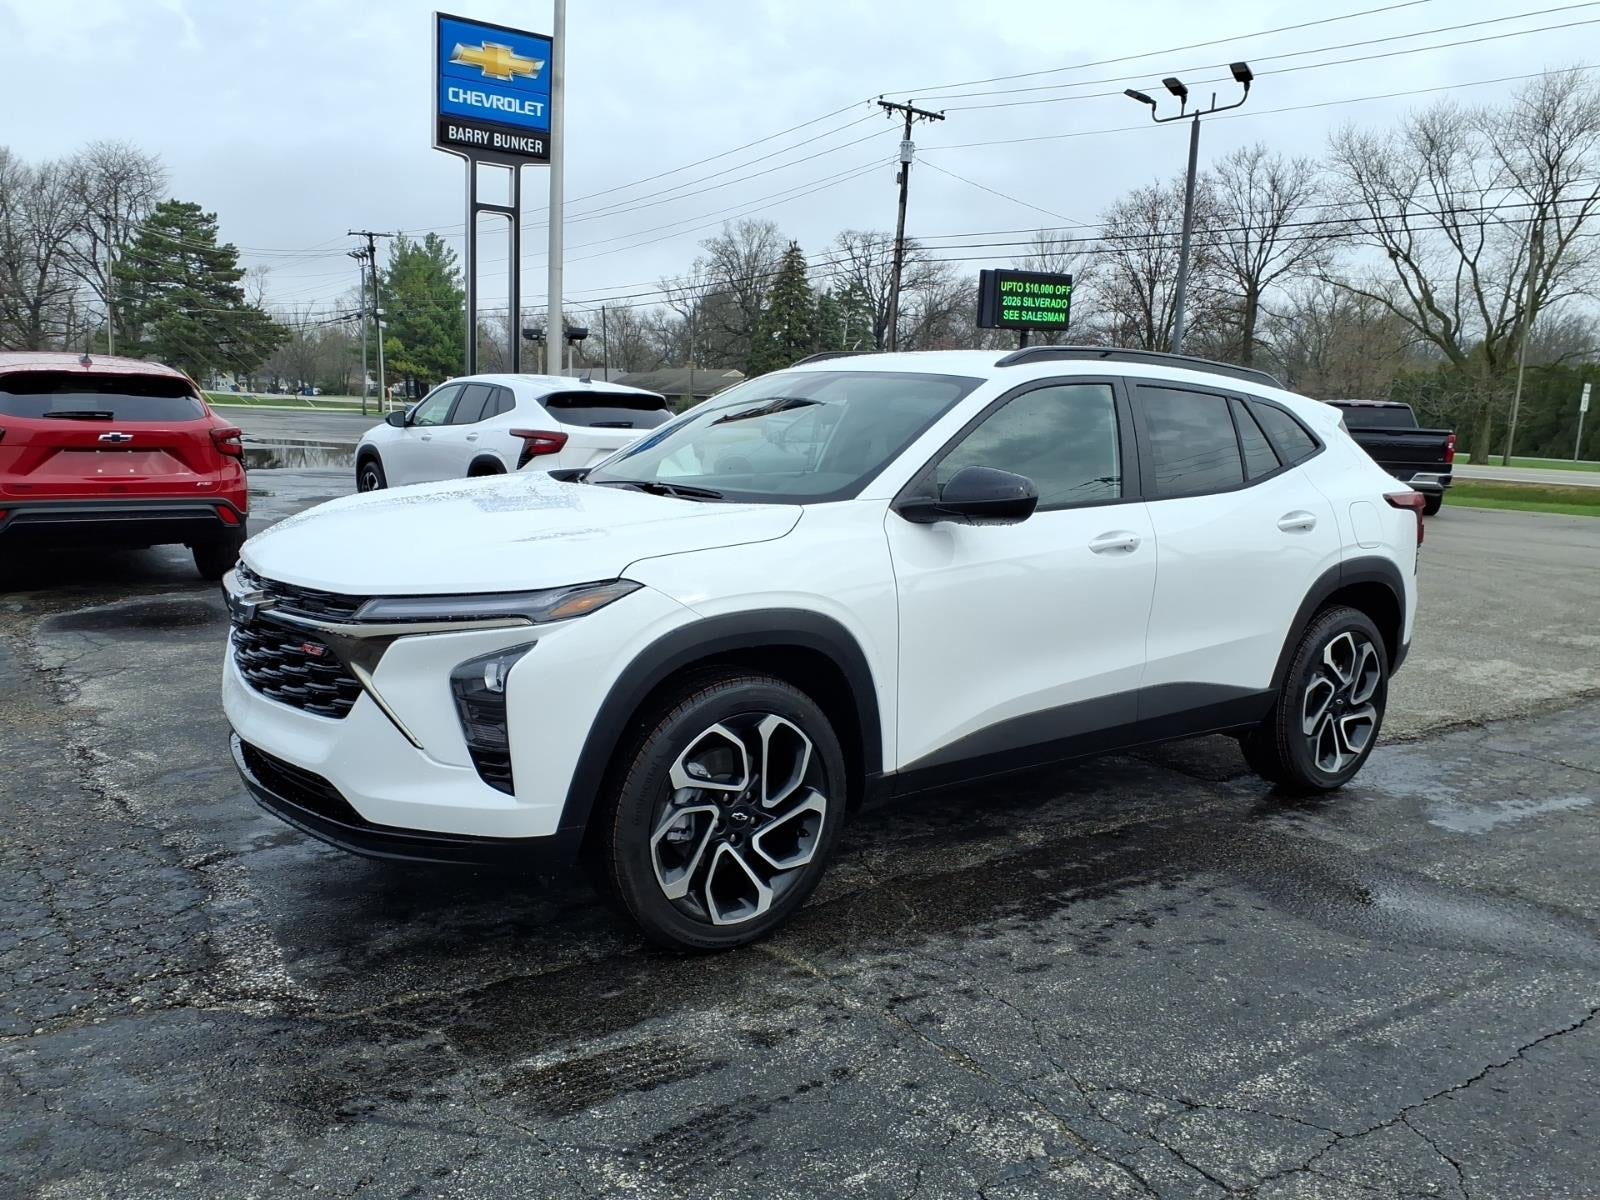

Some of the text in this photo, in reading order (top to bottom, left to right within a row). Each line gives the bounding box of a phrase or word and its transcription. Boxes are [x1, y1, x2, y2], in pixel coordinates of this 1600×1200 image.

[448, 87, 544, 117] CHEVROLET
[448, 125, 543, 153] BARRY BUNKER
[1001, 281, 1071, 295] UPTO $10,000 OFF
[1002, 296, 1068, 308] 2026 SILVERADO
[1003, 310, 1066, 322] SEE SALESMAN
